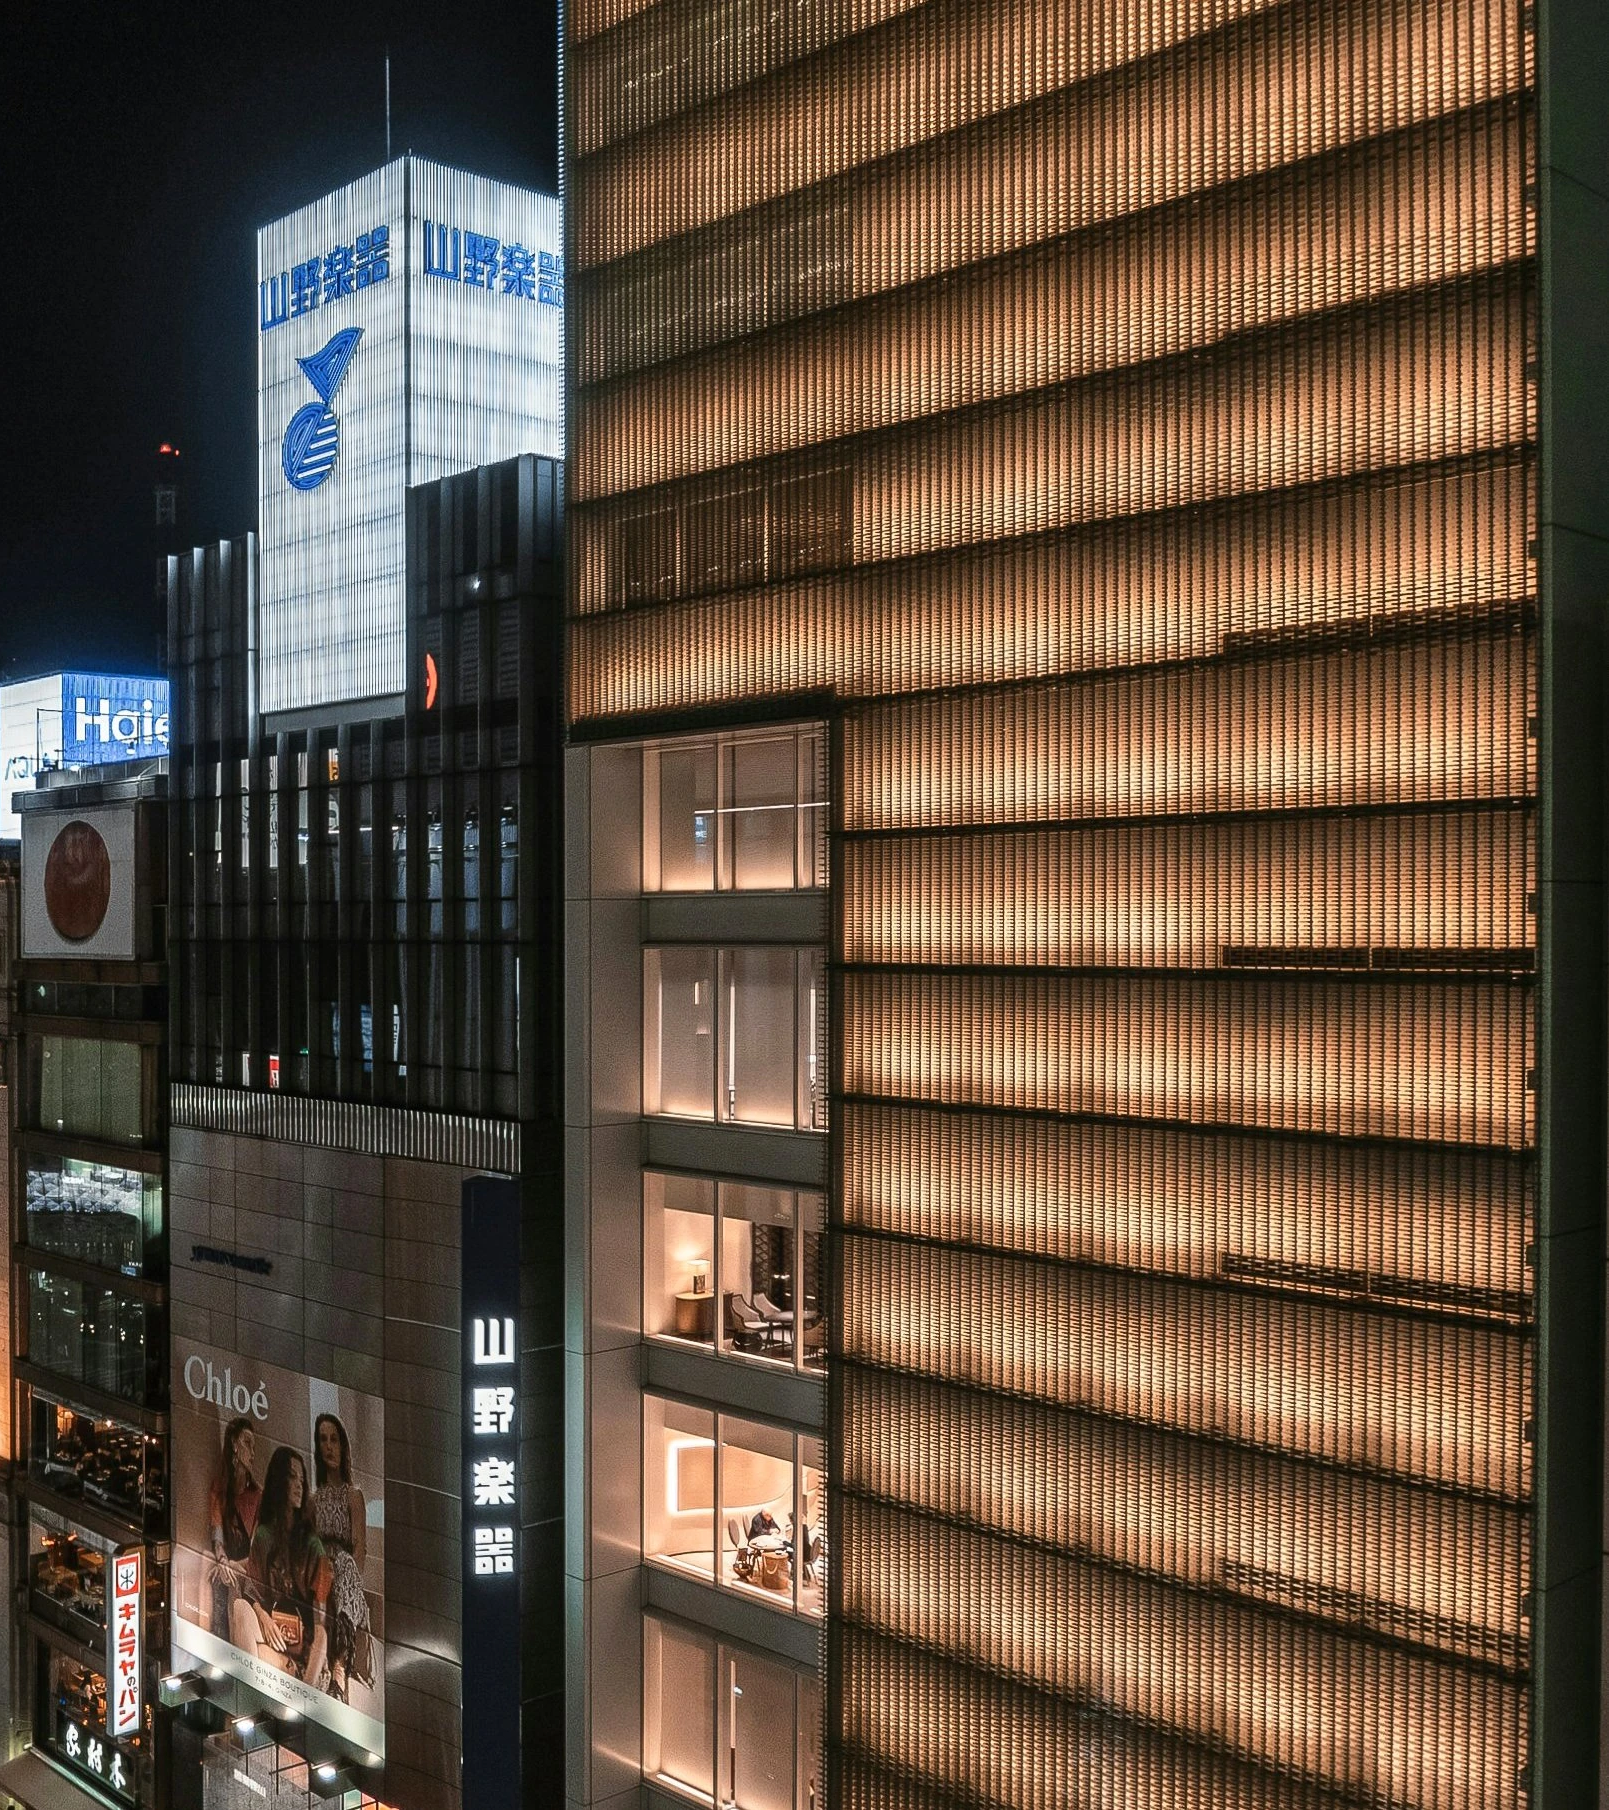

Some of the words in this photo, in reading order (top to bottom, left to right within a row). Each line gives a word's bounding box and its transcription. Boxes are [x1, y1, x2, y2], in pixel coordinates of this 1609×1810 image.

[260, 224, 390, 331] 山野楽器
[184, 1355, 269, 1421] Chloé
[473, 1317, 516, 1575] 山野楽器
[118, 1602, 138, 1727] キムラヤのパン
[256, 1666, 277, 1681] GINZA
[280, 1678, 320, 1704] BOUTIQUE
